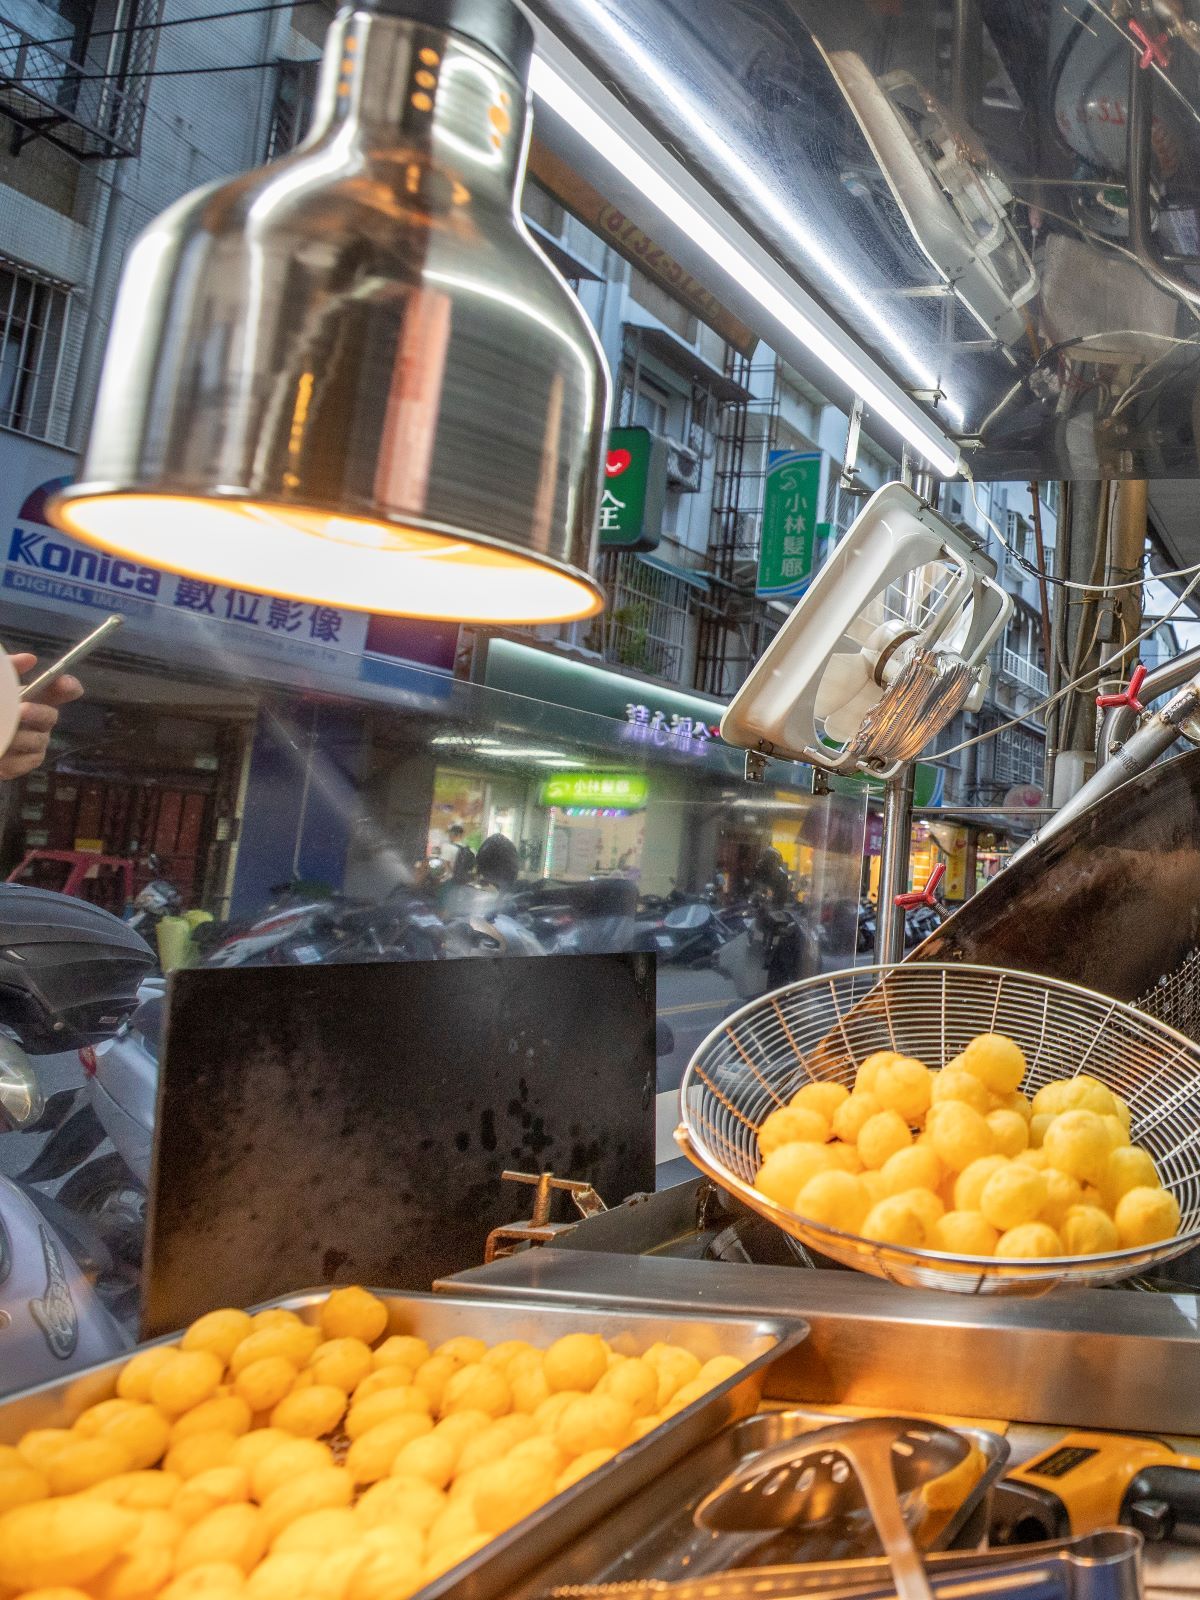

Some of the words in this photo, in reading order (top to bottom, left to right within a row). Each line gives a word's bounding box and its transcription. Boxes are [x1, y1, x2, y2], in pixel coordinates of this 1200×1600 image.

[8, 527, 162, 597] Konica
[780, 492, 808, 578] 小林髮廊
[12, 574, 87, 600] DIGITAL
[173, 575, 343, 642] 數位影像
